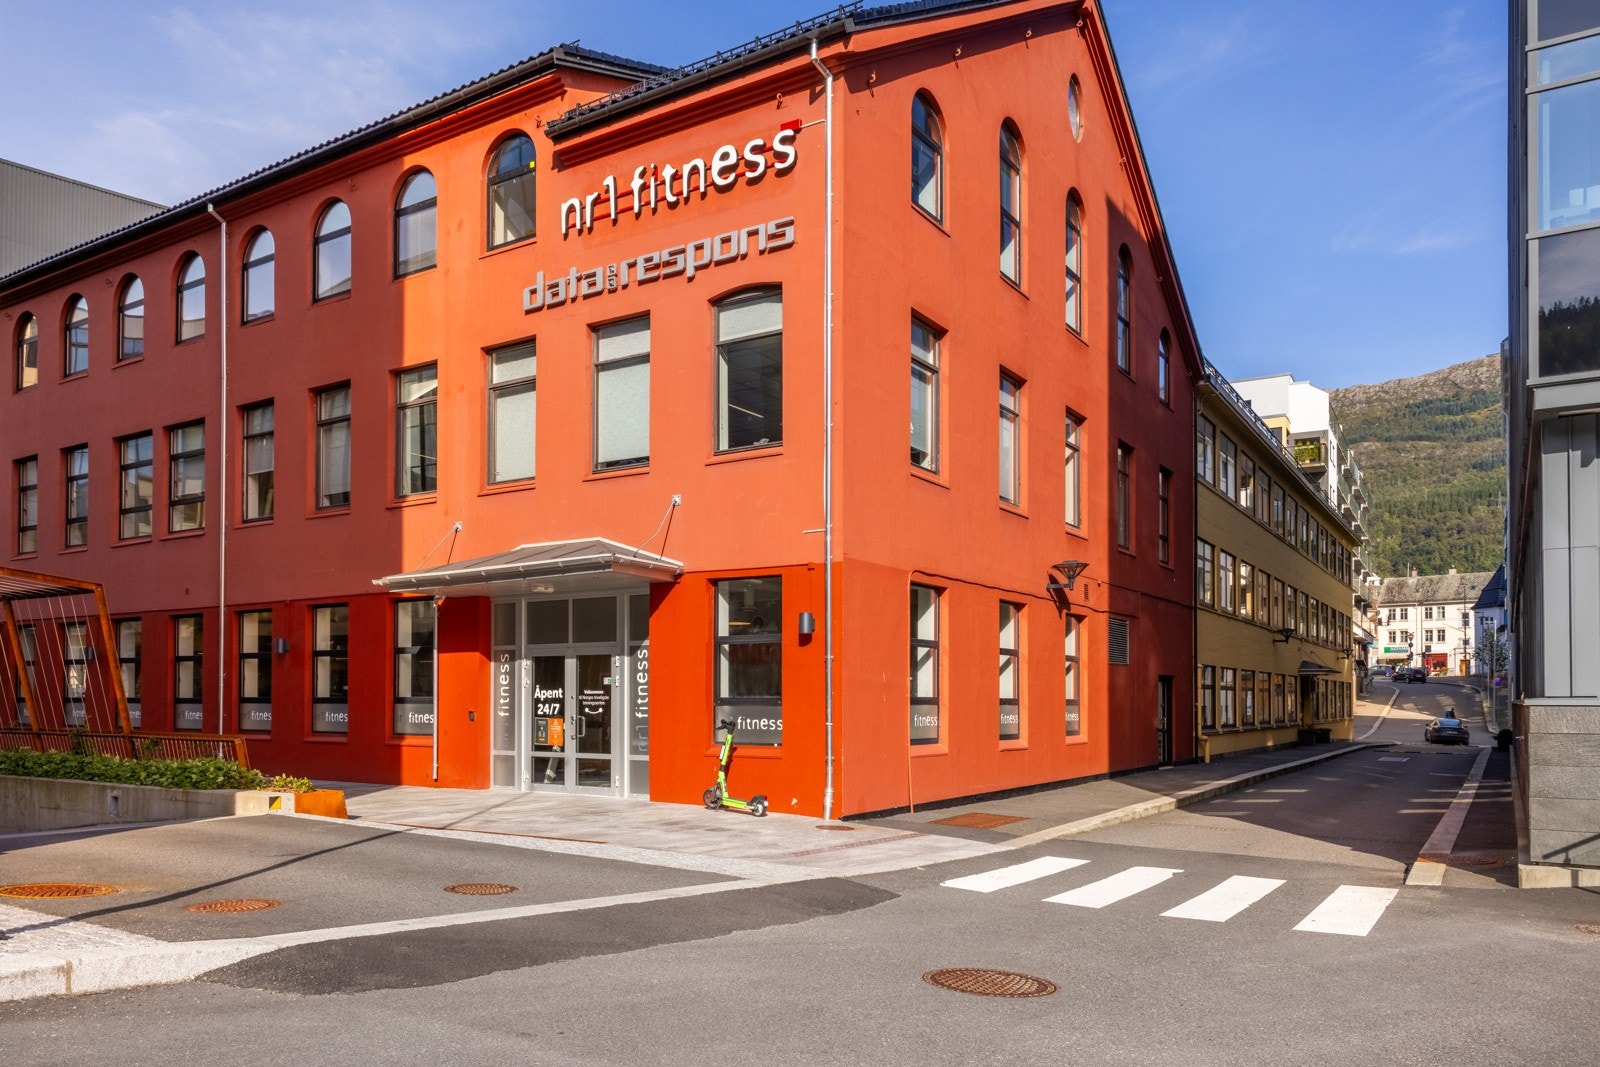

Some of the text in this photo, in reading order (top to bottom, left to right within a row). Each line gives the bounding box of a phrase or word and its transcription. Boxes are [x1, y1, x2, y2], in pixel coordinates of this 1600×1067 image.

[561, 129, 797, 234] nr1 fitness
[523, 265, 604, 311] data
[621, 216, 795, 285] respons
[498, 653, 510, 717] fitness
[635, 649, 648, 718] fitness
[534, 685, 563, 701] Åpent
[537, 703, 561, 716] 24/7
[737, 717, 783, 730] fitness
[914, 714, 938, 727] fitness
[1000, 713, 1018, 724] fitness
